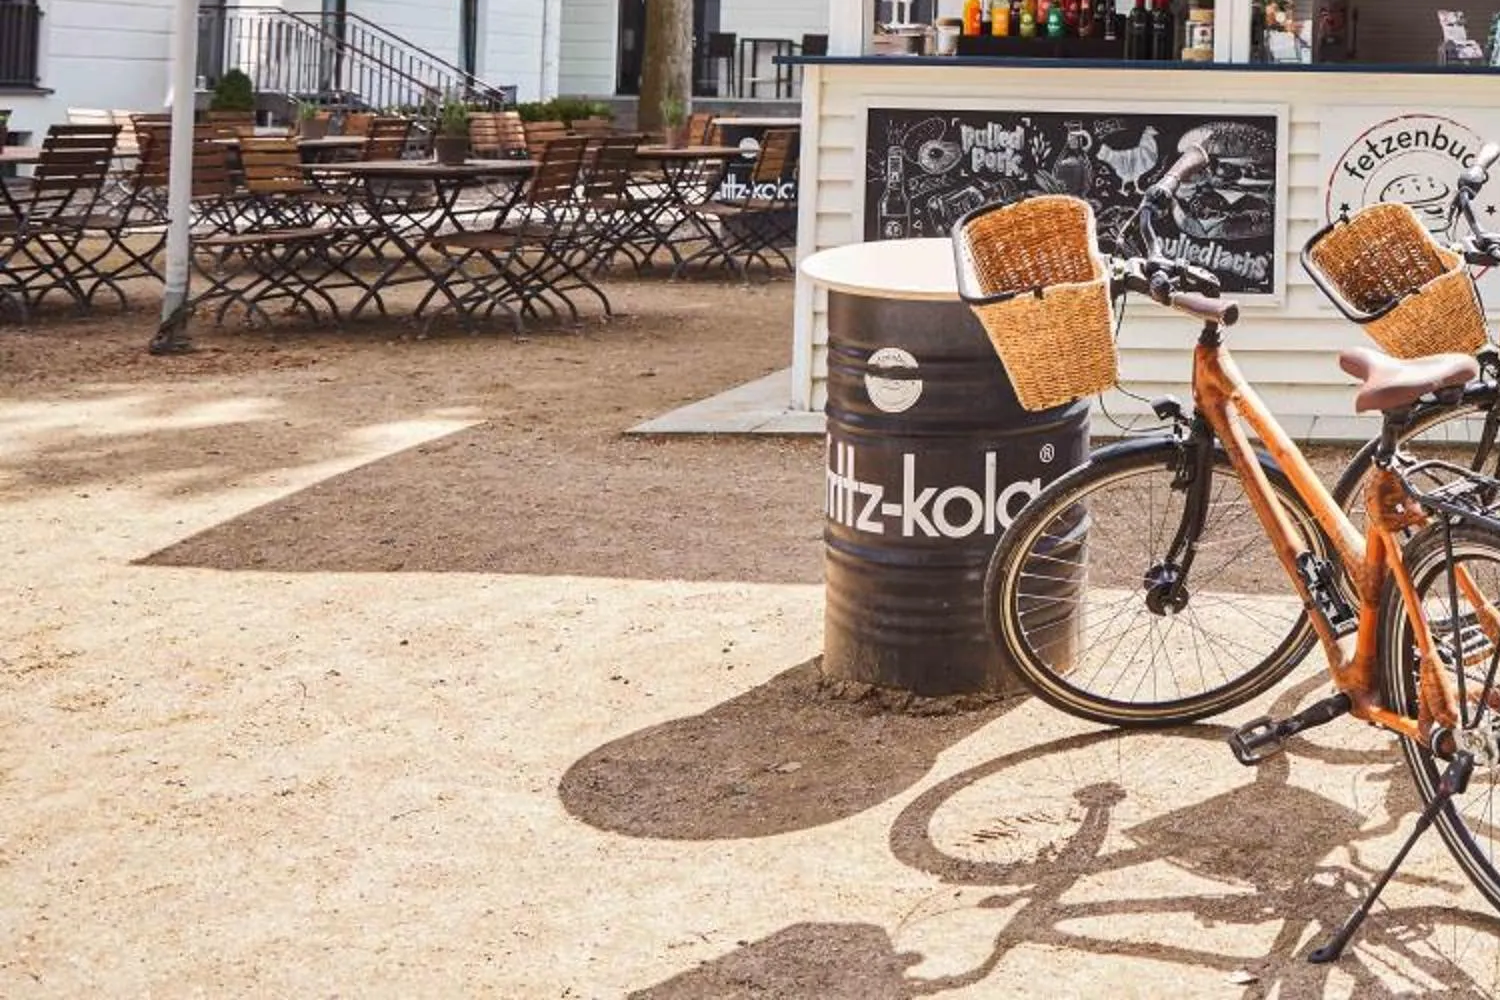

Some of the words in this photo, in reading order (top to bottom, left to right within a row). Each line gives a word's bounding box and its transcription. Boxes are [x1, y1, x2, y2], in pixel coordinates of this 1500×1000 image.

[1344, 124, 1476, 180] fetzenbu
[721, 173, 795, 200] ritz-kola
[827, 434, 1042, 538] ritz-kola
